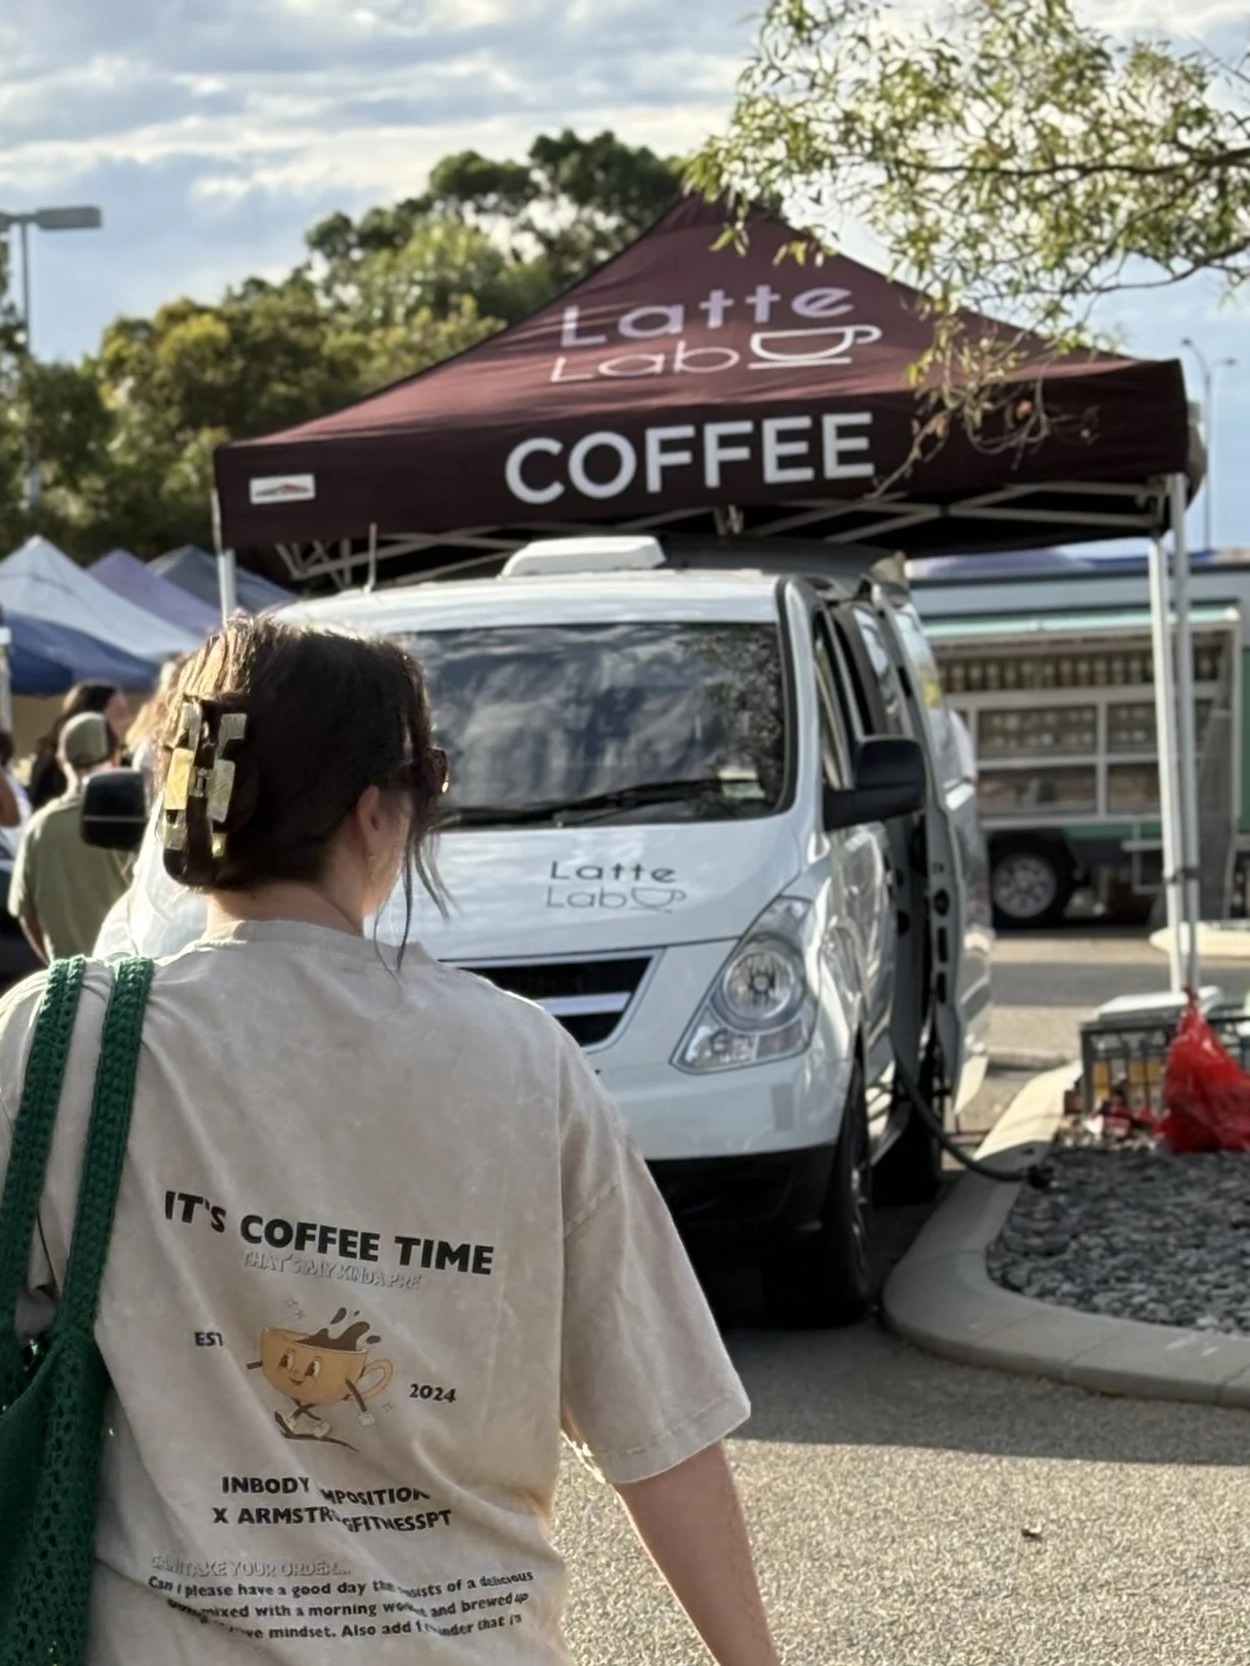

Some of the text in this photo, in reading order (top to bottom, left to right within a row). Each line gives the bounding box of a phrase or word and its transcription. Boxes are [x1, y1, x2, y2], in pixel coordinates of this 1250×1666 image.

[560, 284, 854, 348] Latte
[550, 341, 740, 383] Lab
[504, 411, 875, 504] COFFEE
[550, 860, 676, 884] Latte
[546, 886, 628, 910] Lab
[164, 1190, 494, 1275] IT'S COFFEE TIME
[409, 1383, 457, 1403] 2024
[222, 1476, 310, 1494] INBODY
[212, 1507, 228, 1524] X
[148, 1575, 173, 1592] Can
[185, 1583, 233, 1599] please
[238, 1583, 278, 1596] have
[278, 1586, 286, 1596] a
[292, 1582, 331, 1599] good
[337, 1581, 366, 1597] day
[447, 1578, 463, 1592] of
[467, 1578, 476, 1589] a
[479, 1570, 534, 1588] delicious
[255, 1604, 291, 1617] with
[295, 1607, 304, 1617] a
[308, 1603, 377, 1618] morning
[431, 1602, 456, 1618] and
[461, 1592, 513, 1613] brewed
[269, 1625, 337, 1639] mindset.
[341, 1624, 376, 1638] Also
[381, 1620, 412, 1636] add
[478, 1614, 505, 1631] that
